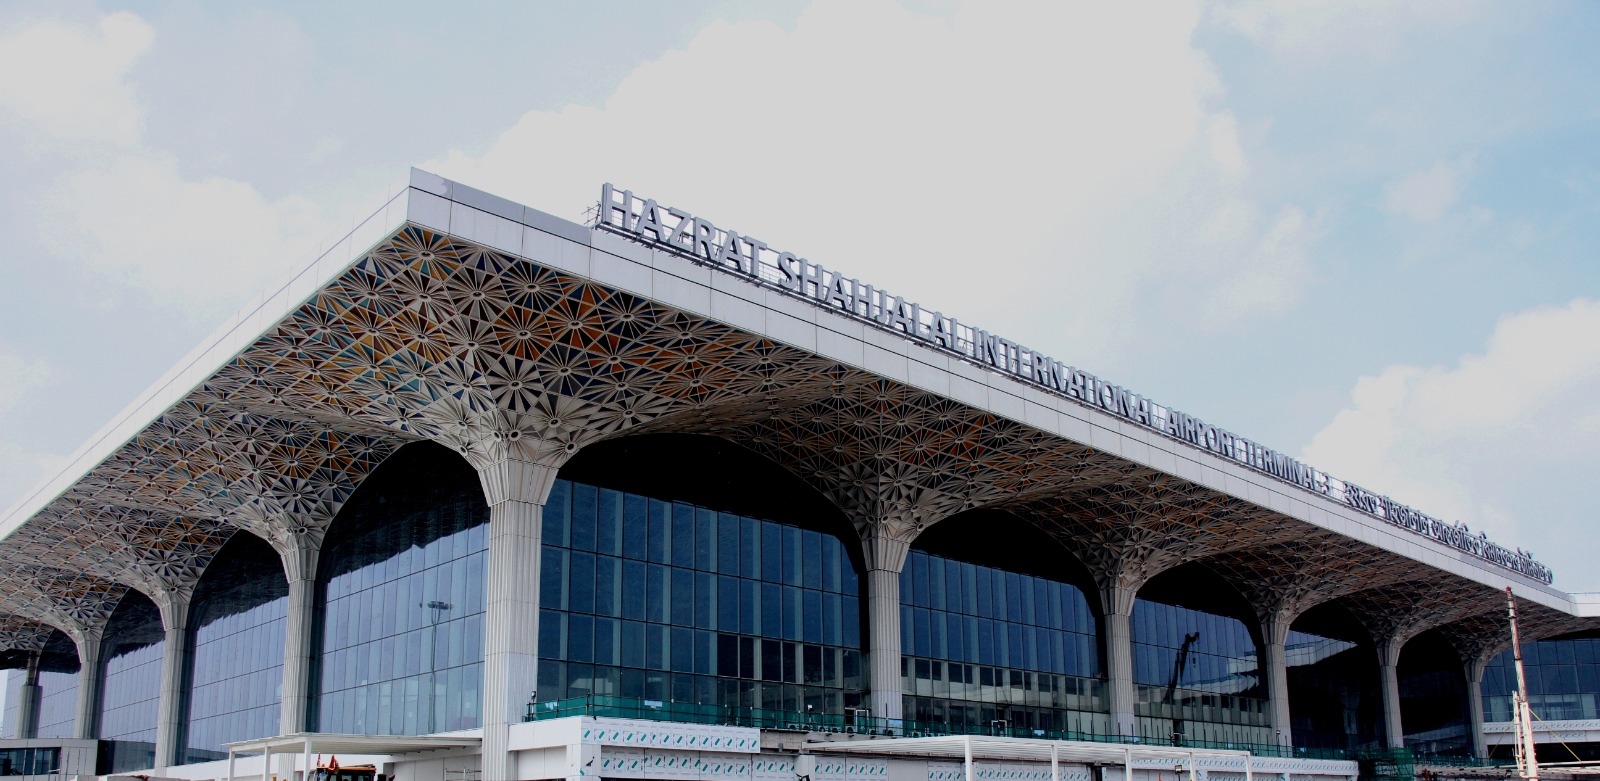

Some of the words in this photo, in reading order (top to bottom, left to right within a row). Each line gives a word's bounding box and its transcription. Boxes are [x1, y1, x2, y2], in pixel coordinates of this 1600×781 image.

[601, 182, 767, 277] HAZRAT
[777, 252, 965, 351] SHAHJALAL
[972, 326, 1155, 426] INTERNATIONAL
[1164, 407, 1240, 460] AIRPORT
